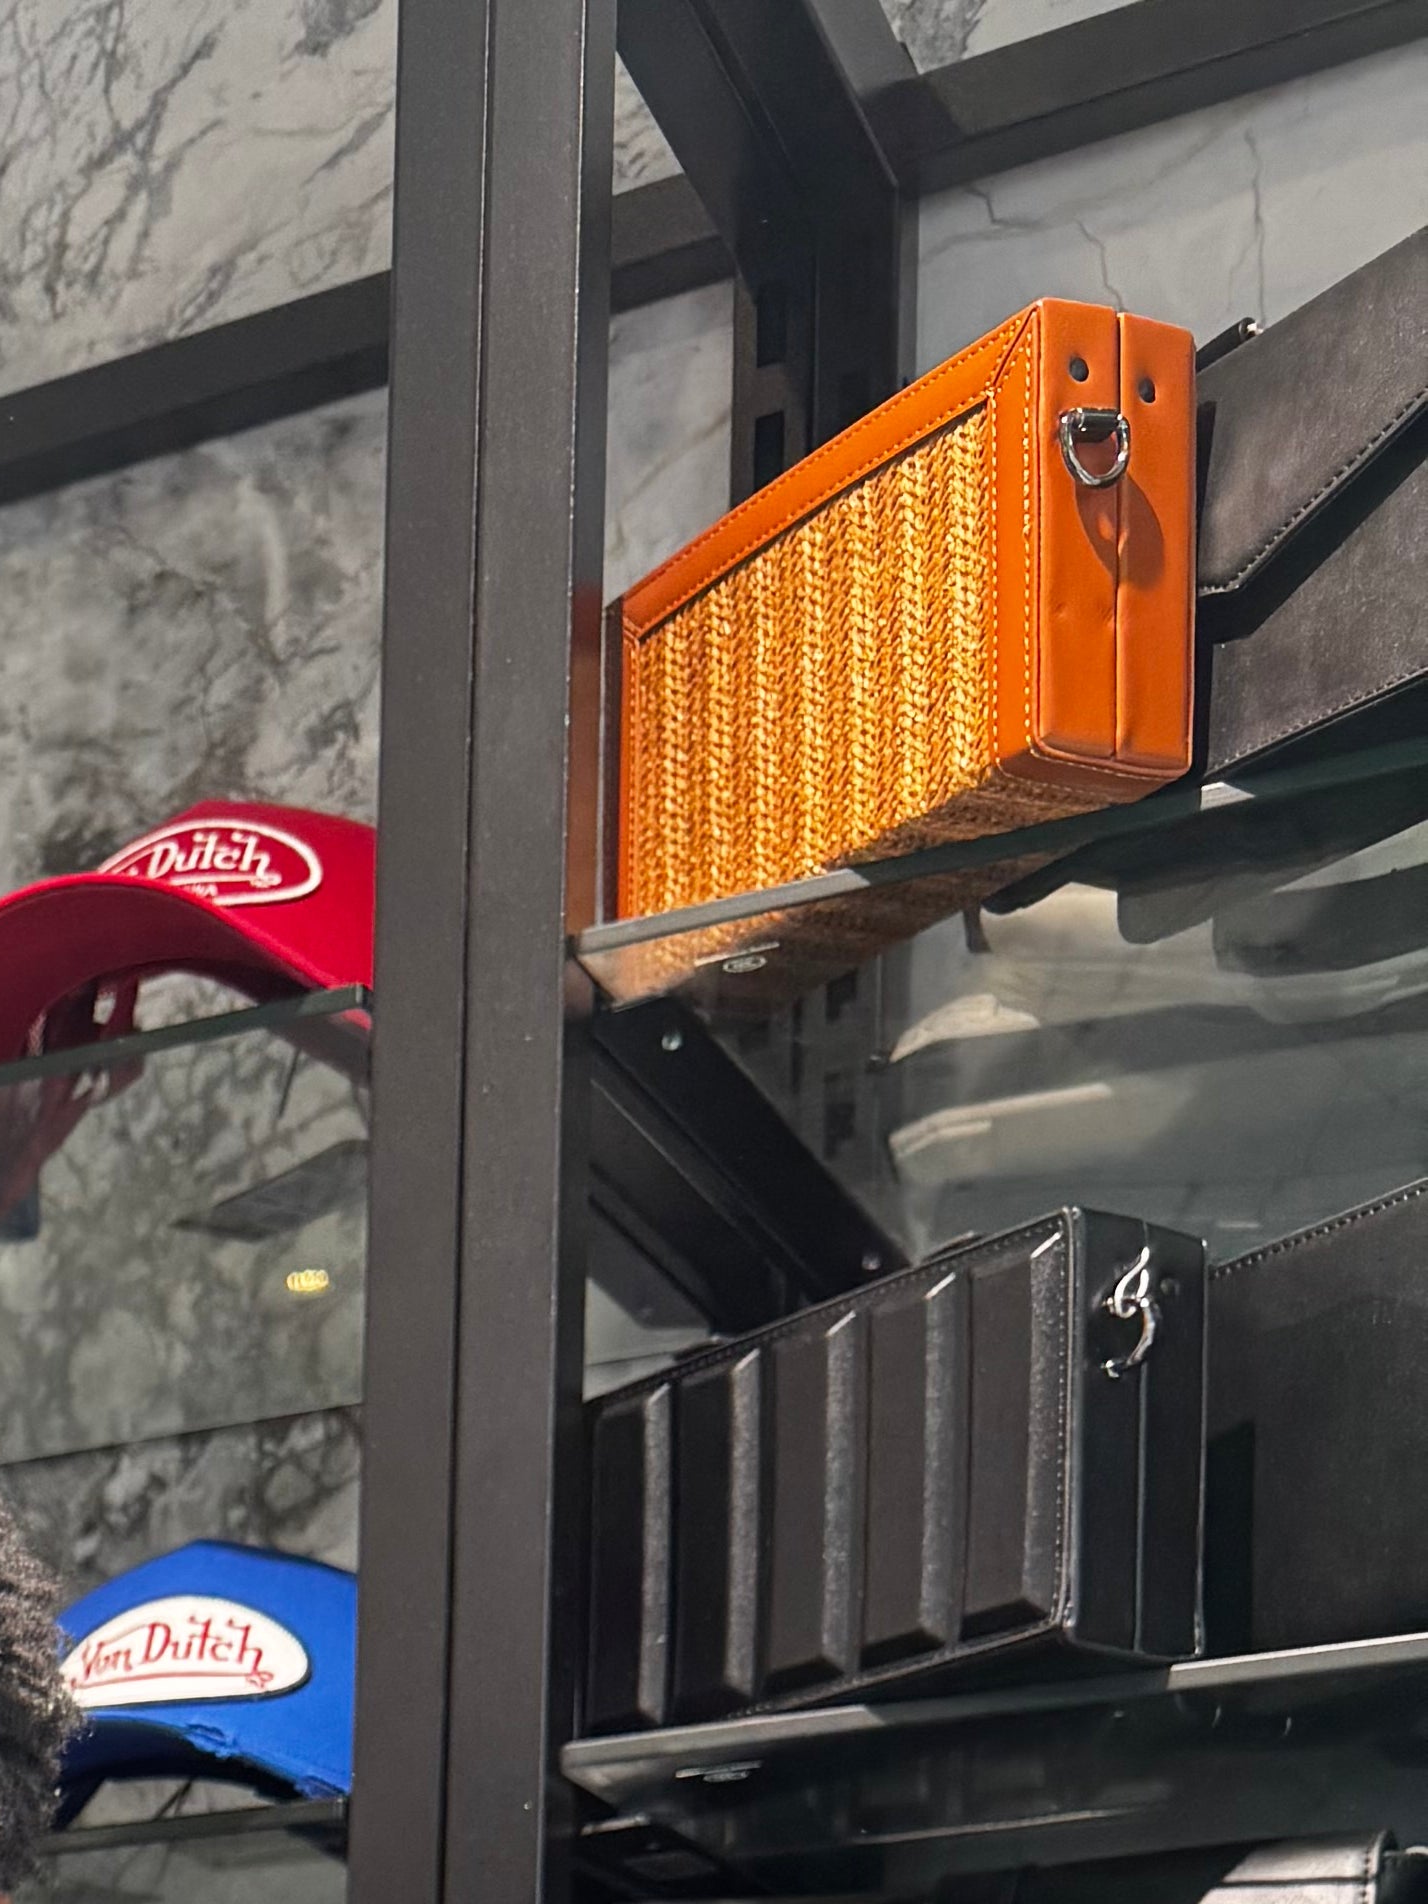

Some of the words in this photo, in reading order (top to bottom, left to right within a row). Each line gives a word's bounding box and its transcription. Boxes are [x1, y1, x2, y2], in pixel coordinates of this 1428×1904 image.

[145, 831, 282, 888] Dutch
[79, 1638, 134, 1682] Von
[137, 1613, 275, 1689] Dutch
